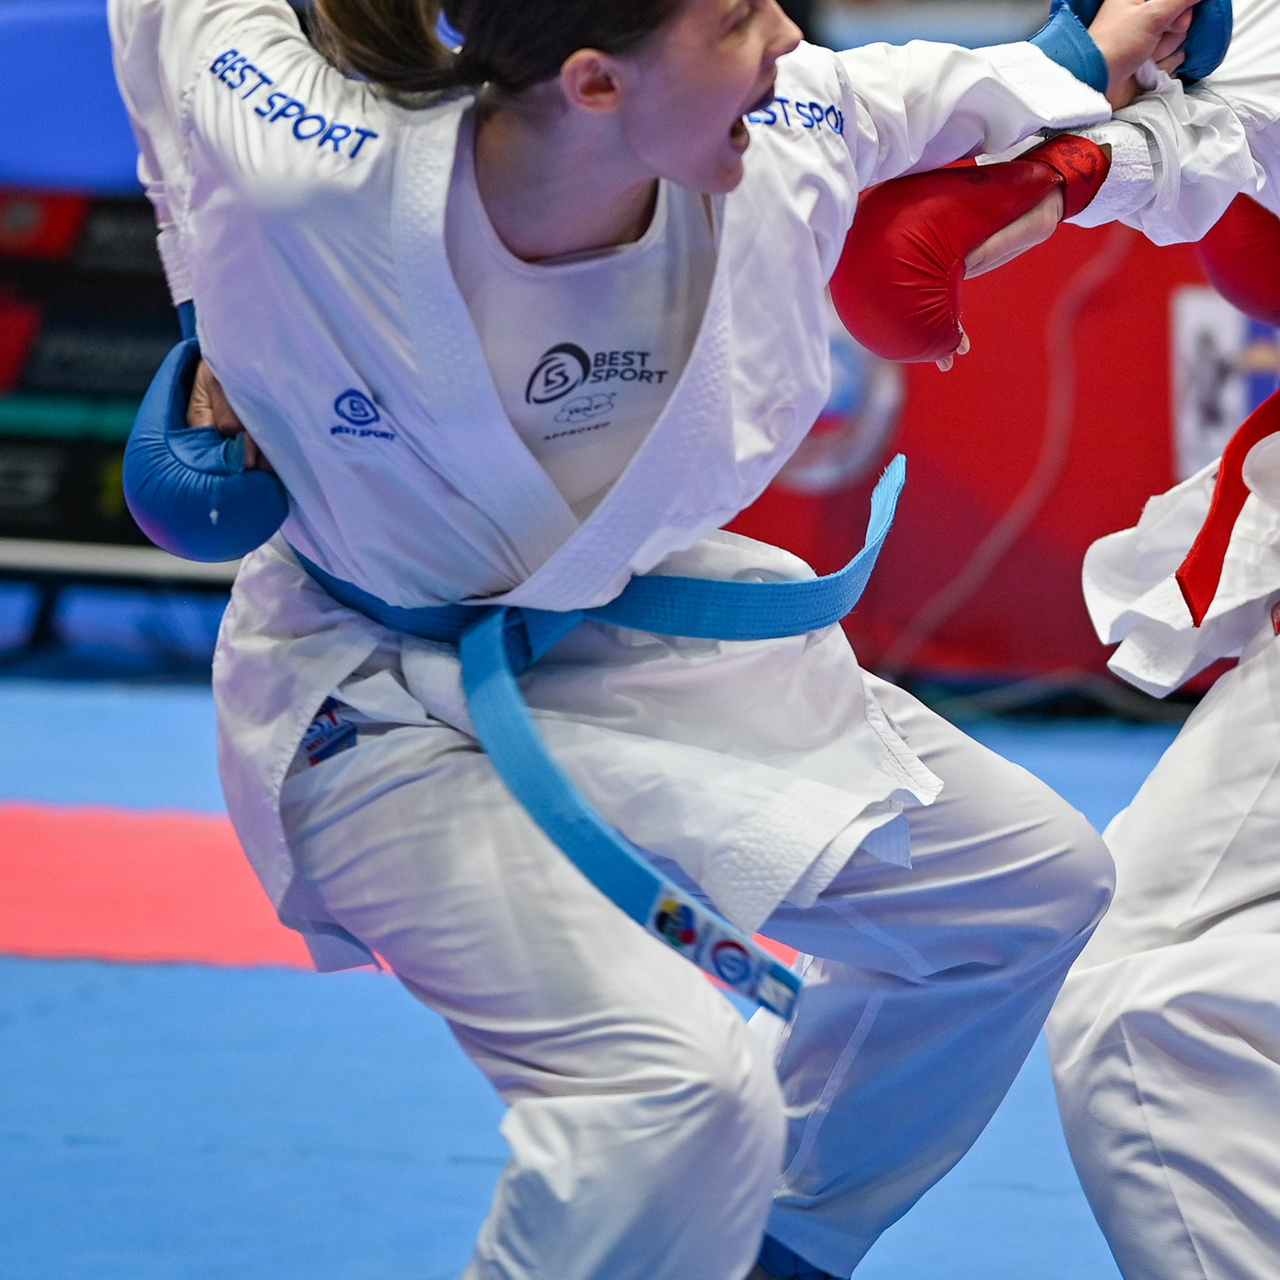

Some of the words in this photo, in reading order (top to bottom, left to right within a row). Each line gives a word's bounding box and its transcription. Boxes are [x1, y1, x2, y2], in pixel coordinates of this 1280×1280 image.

[210, 49, 273, 100] BEST
[255, 91, 379, 159] SPORT
[593, 350, 651, 368] BEST
[589, 367, 668, 384] SPORT
[330, 425, 357, 436] BEST
[359, 429, 395, 441] SPORT
